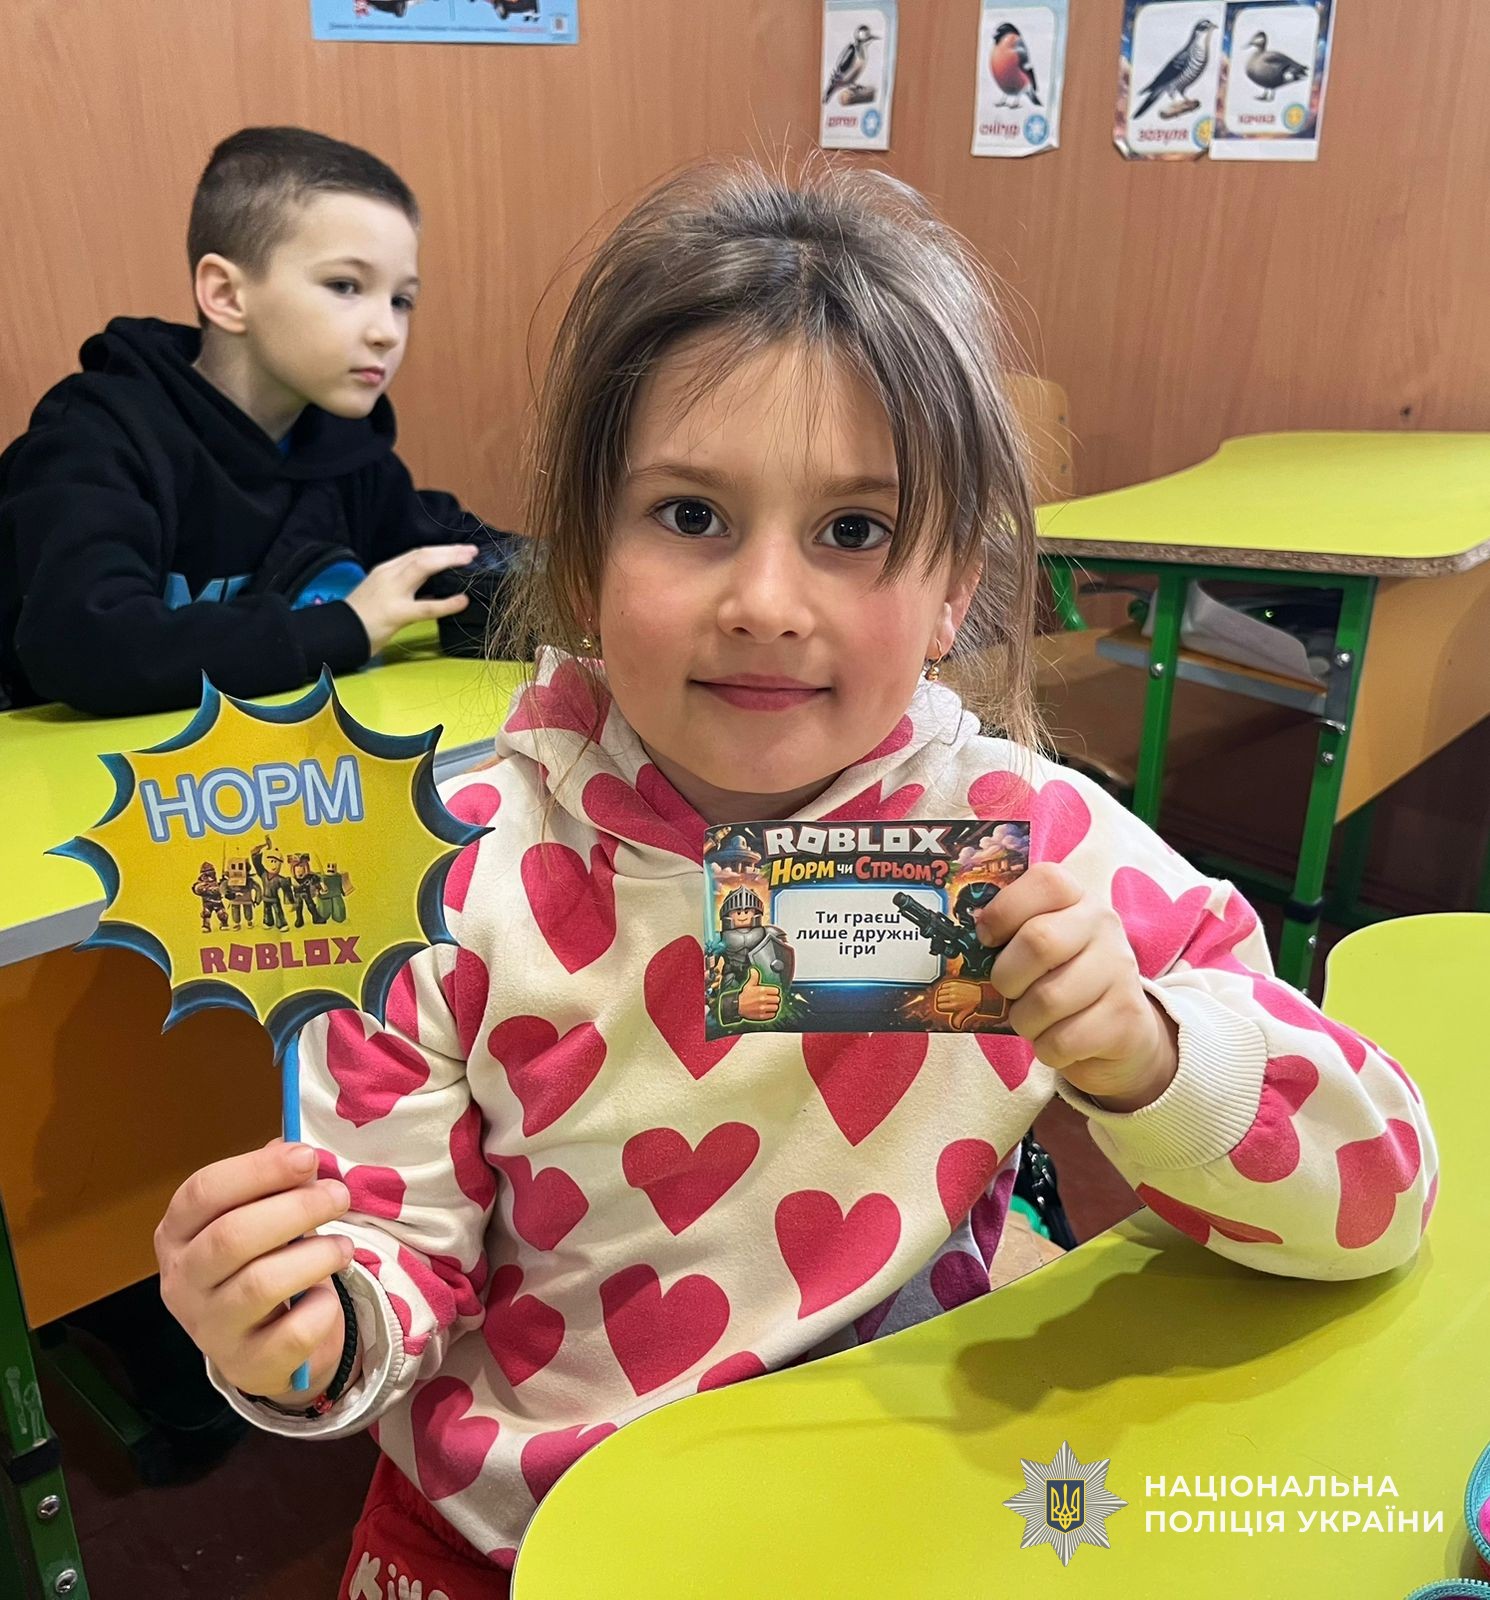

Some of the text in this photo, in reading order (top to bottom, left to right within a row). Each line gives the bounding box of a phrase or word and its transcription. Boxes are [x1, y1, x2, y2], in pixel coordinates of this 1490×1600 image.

[140, 754, 365, 843] НОРМ
[764, 826, 951, 857] ROBLOX
[815, 911, 901, 928] Ти граєш
[796, 927, 920, 943] лише дружні
[199, 935, 363, 974] ROBLOX
[838, 941, 876, 957] ігри
